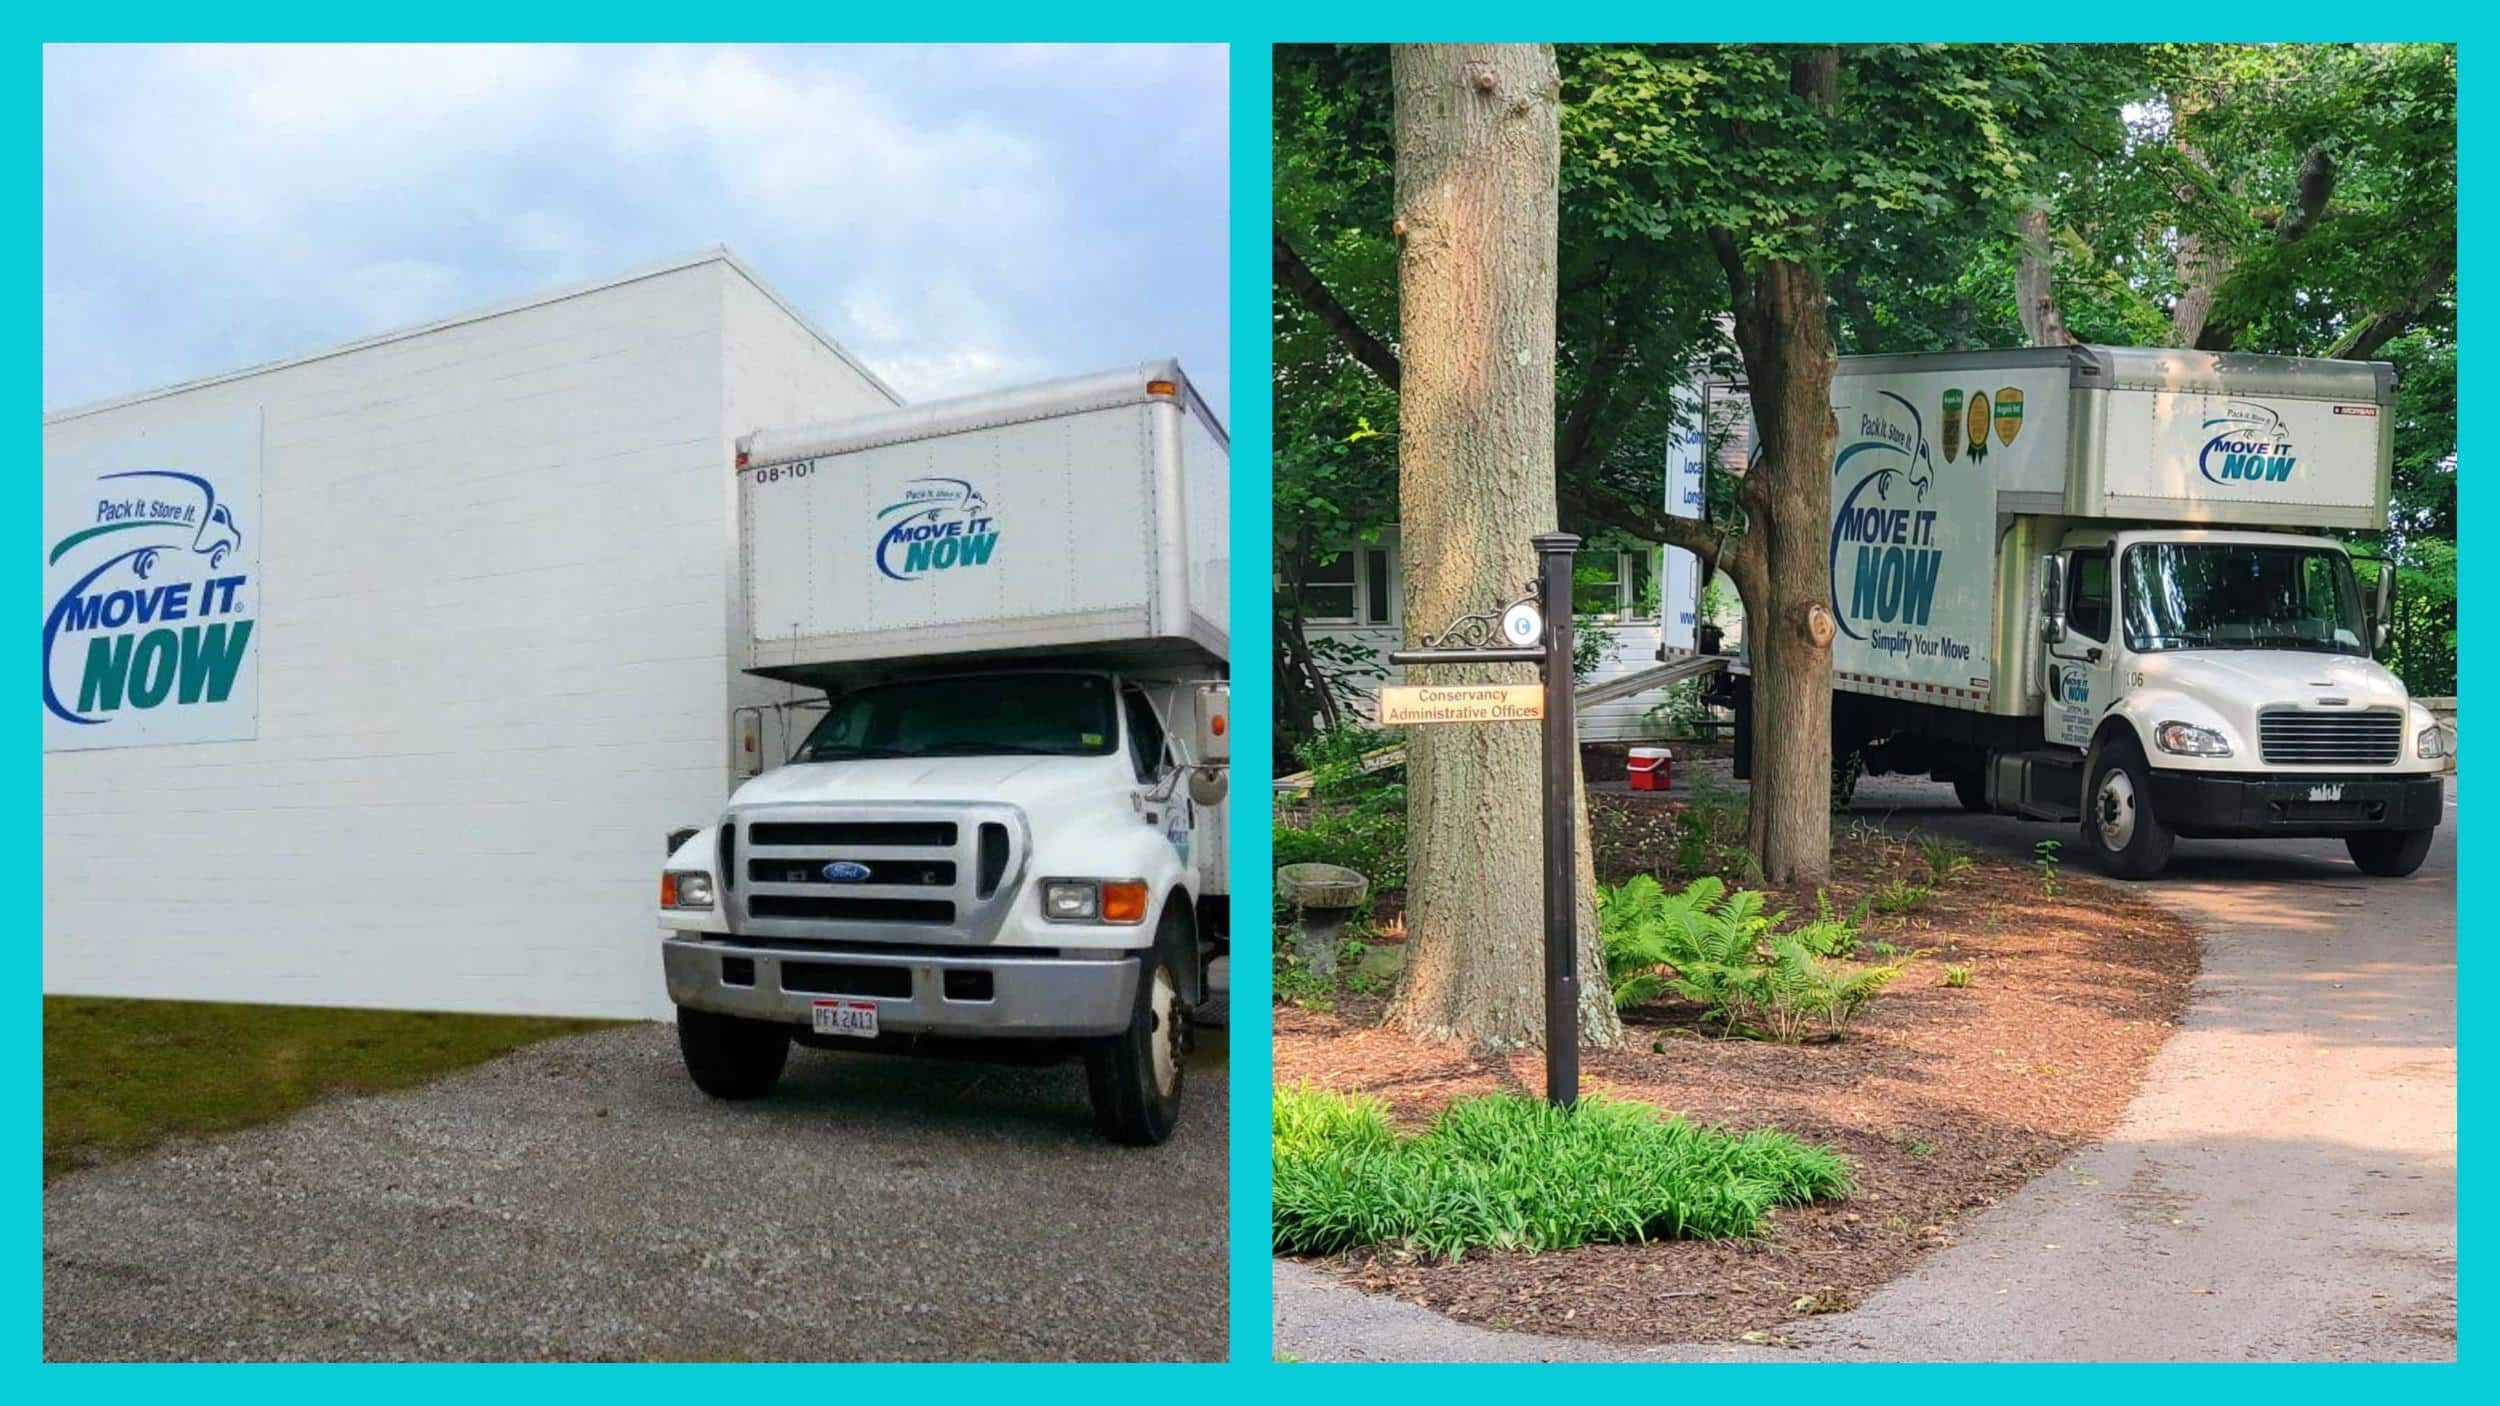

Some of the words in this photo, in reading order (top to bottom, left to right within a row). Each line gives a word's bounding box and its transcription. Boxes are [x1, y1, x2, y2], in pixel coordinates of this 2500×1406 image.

[1861, 414, 1881, 436] Pack
[2214, 441, 2270, 455] MOVE
[2273, 443, 2293, 455] IT
[757, 461, 815, 484] 08-101
[2221, 455, 2296, 482] NOW
[97, 499, 131, 523] Pack
[149, 501, 182, 522] Store
[893, 521, 963, 544] MOVE
[968, 517, 992, 534] IT
[1843, 507, 1910, 544] MOVE
[904, 532, 998, 572] NOW
[1850, 545, 1943, 627] NOW
[65, 583, 192, 632] MOVE
[198, 575, 247, 617] IT
[1871, 628, 1912, 658] Simplify
[1914, 634, 1939, 656] Your
[1940, 636, 1970, 660] Move
[77, 620, 254, 713] NOW
[1419, 689, 1508, 703] Conservancy
[1389, 708, 1487, 721] Administrative
[1491, 704, 1539, 718] Offices
